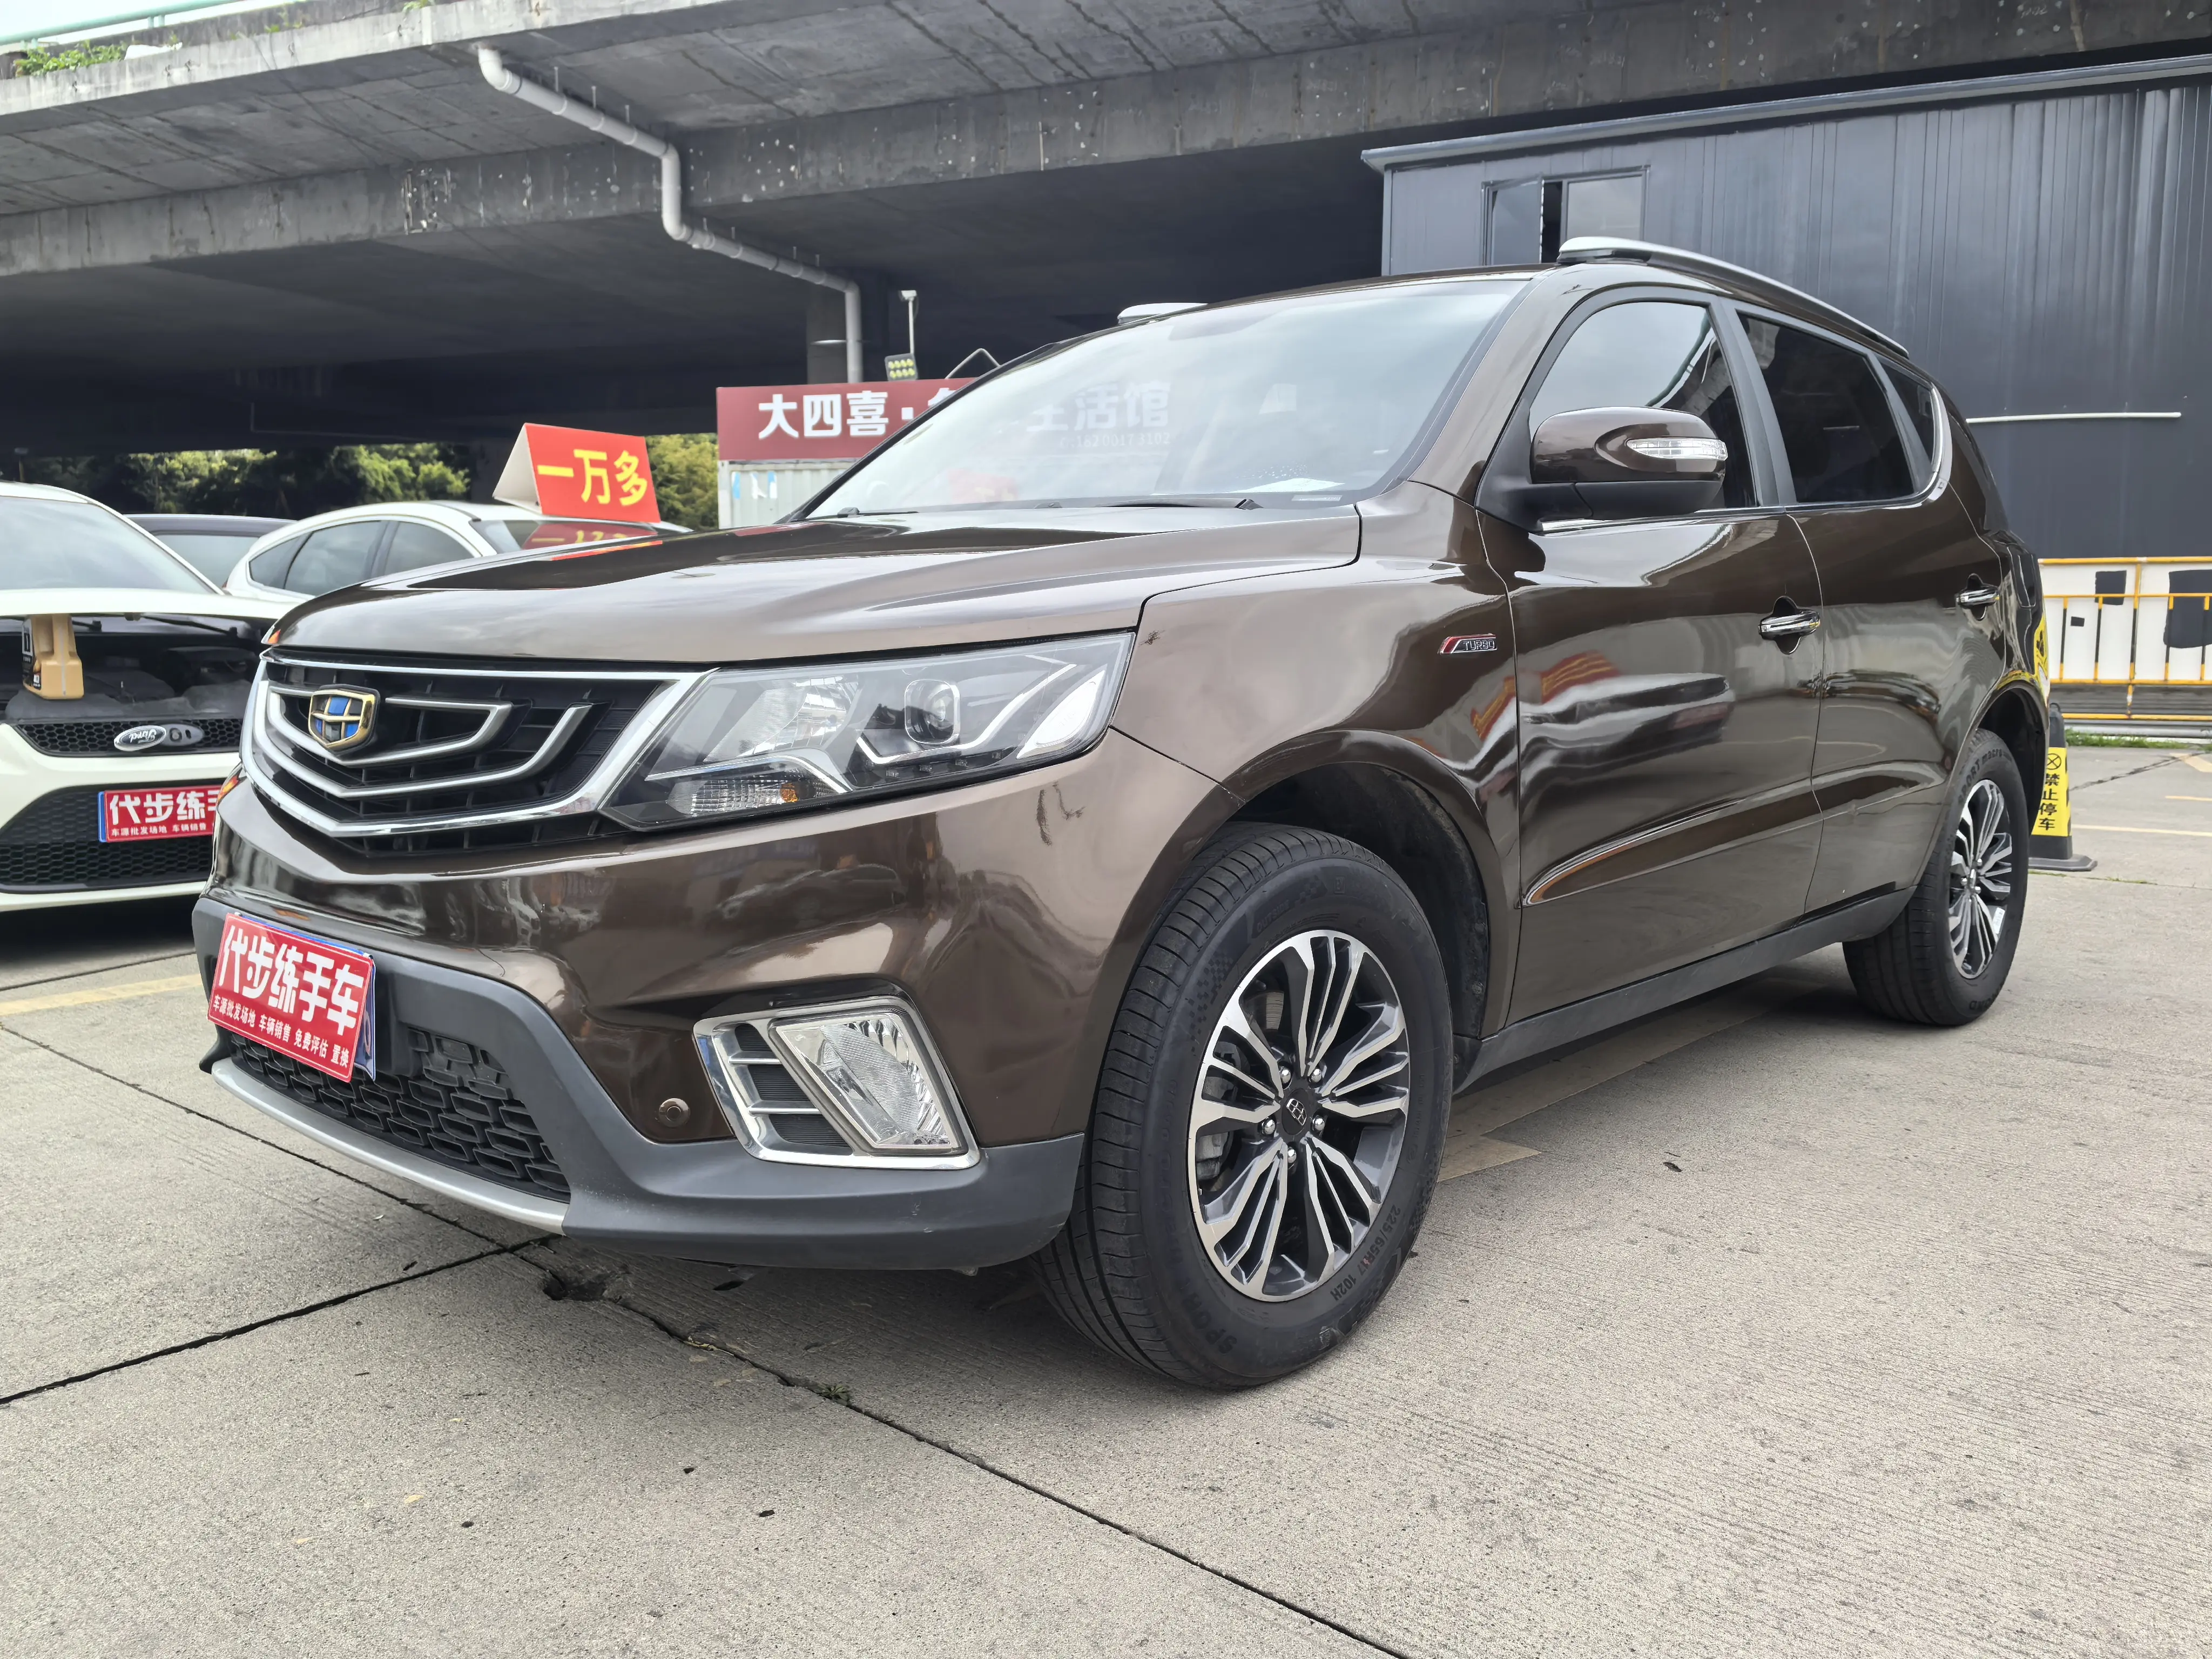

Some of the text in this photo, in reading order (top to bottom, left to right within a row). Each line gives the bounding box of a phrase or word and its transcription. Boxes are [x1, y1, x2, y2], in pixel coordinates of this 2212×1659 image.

[537, 448, 648, 507] 一万多
[1462, 639, 1495, 651] TURBO
[2038, 773, 2060, 831] 禁止停车
[218, 925, 365, 1036] 代步练手车
[213, 994, 350, 1068] 车源批发场地 车辆销售 免费评估 置换
[1330, 1274, 1357, 1301] 102H
